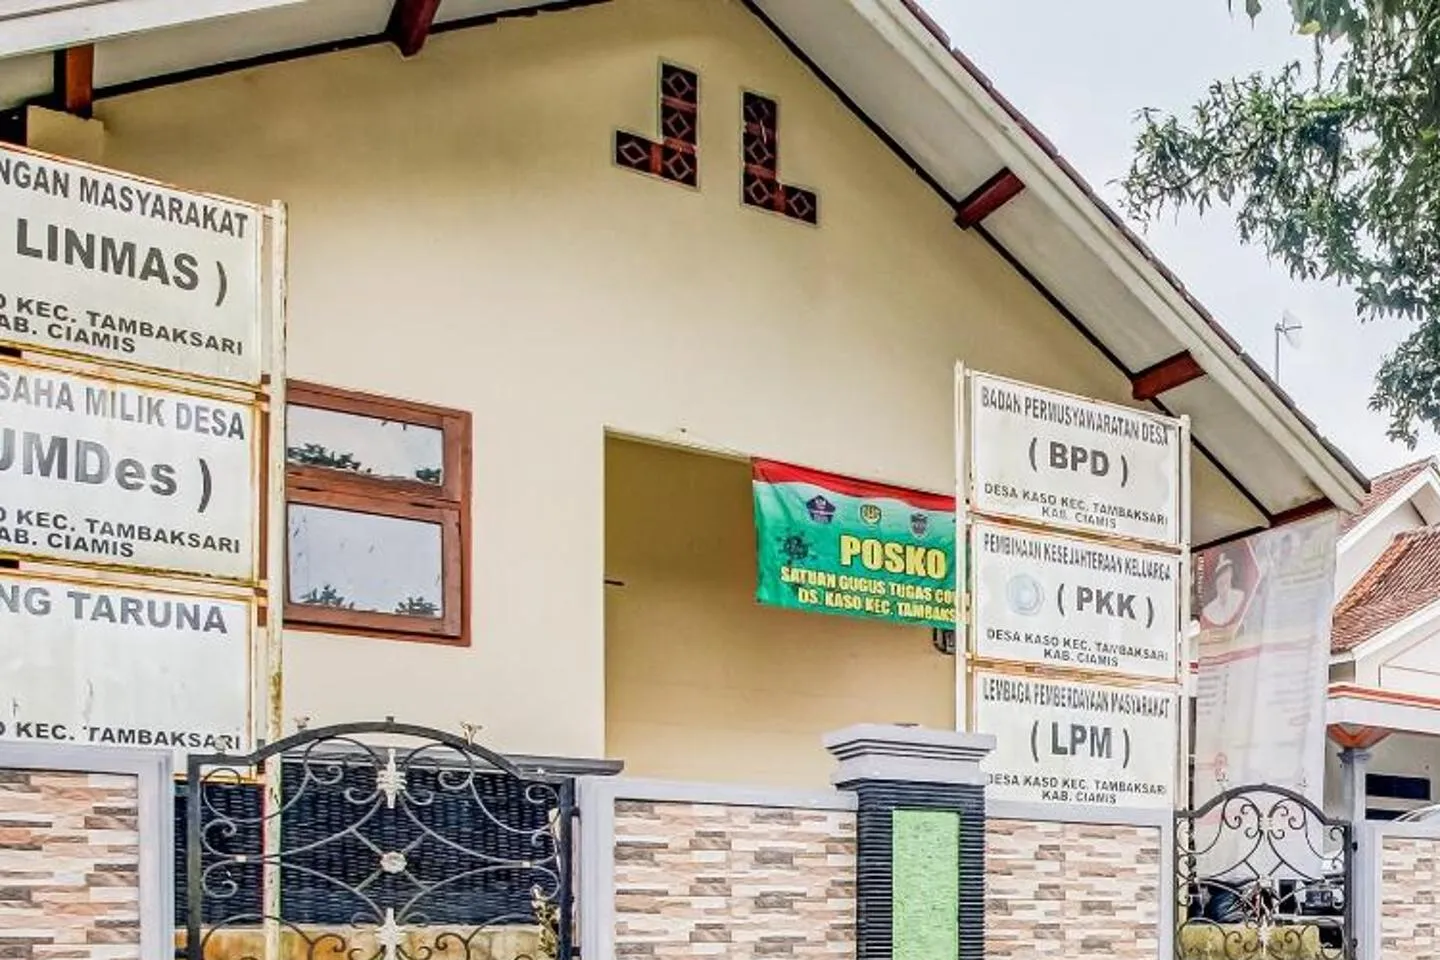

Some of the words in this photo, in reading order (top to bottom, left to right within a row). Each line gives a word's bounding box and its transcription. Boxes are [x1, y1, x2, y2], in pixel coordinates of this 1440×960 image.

[79, 175, 249, 239] MASYARAKAT
[16, 217, 200, 291] LINMAS
[16, 296, 77, 323] KEC.
[86, 310, 243, 356] TAMBAKSARI
[47, 323, 136, 353] CIAMIS
[85, 386, 165, 428] MILIK
[176, 402, 245, 440] DESA
[981, 386, 1021, 414] BADAN
[1024, 396, 1140, 444] PERMUSYAWARATAN
[1142, 422, 1169, 446] DESA
[1049, 440, 1110, 477] BPD
[984, 482, 1019, 499] DESA
[1022, 488, 1057, 506] KASO
[1061, 496, 1089, 512] KEC.
[1093, 502, 1169, 526] TAMBAKSARI
[1075, 511, 1117, 529] CIAMIS
[16, 508, 76, 532] KEC.
[85, 518, 241, 553] TAMBAKSARI
[47, 533, 135, 557] CIAMIS
[839, 534, 949, 580] POSKO
[780, 566, 836, 588] SATUAN
[839, 575, 886, 595] GUGUS
[889, 581, 932, 602] TUGAS
[935, 588, 957, 605] CO
[1076, 585, 1137, 620] PKK
[67, 590, 228, 634] TARUNA
[825, 590, 862, 610] KASO
[865, 597, 893, 616] KEC.
[896, 601, 957, 622] TAMBAKS
[986, 627, 1021, 642] DESA
[1025, 633, 1059, 647] KASO
[1063, 636, 1092, 651] KEC.
[1043, 648, 1074, 662] KAB.
[1077, 652, 1119, 667] CIAMIS
[16, 721, 75, 741] KEC.
[82, 725, 241, 750] TAMBAKSARI
[1051, 721, 1113, 760] LPM
[1023, 775, 1058, 789] KASO
[1094, 780, 1168, 796] TAMBAKSAR
[1042, 790, 1072, 802] KAB.
[1075, 791, 1117, 805] CIAMIS
